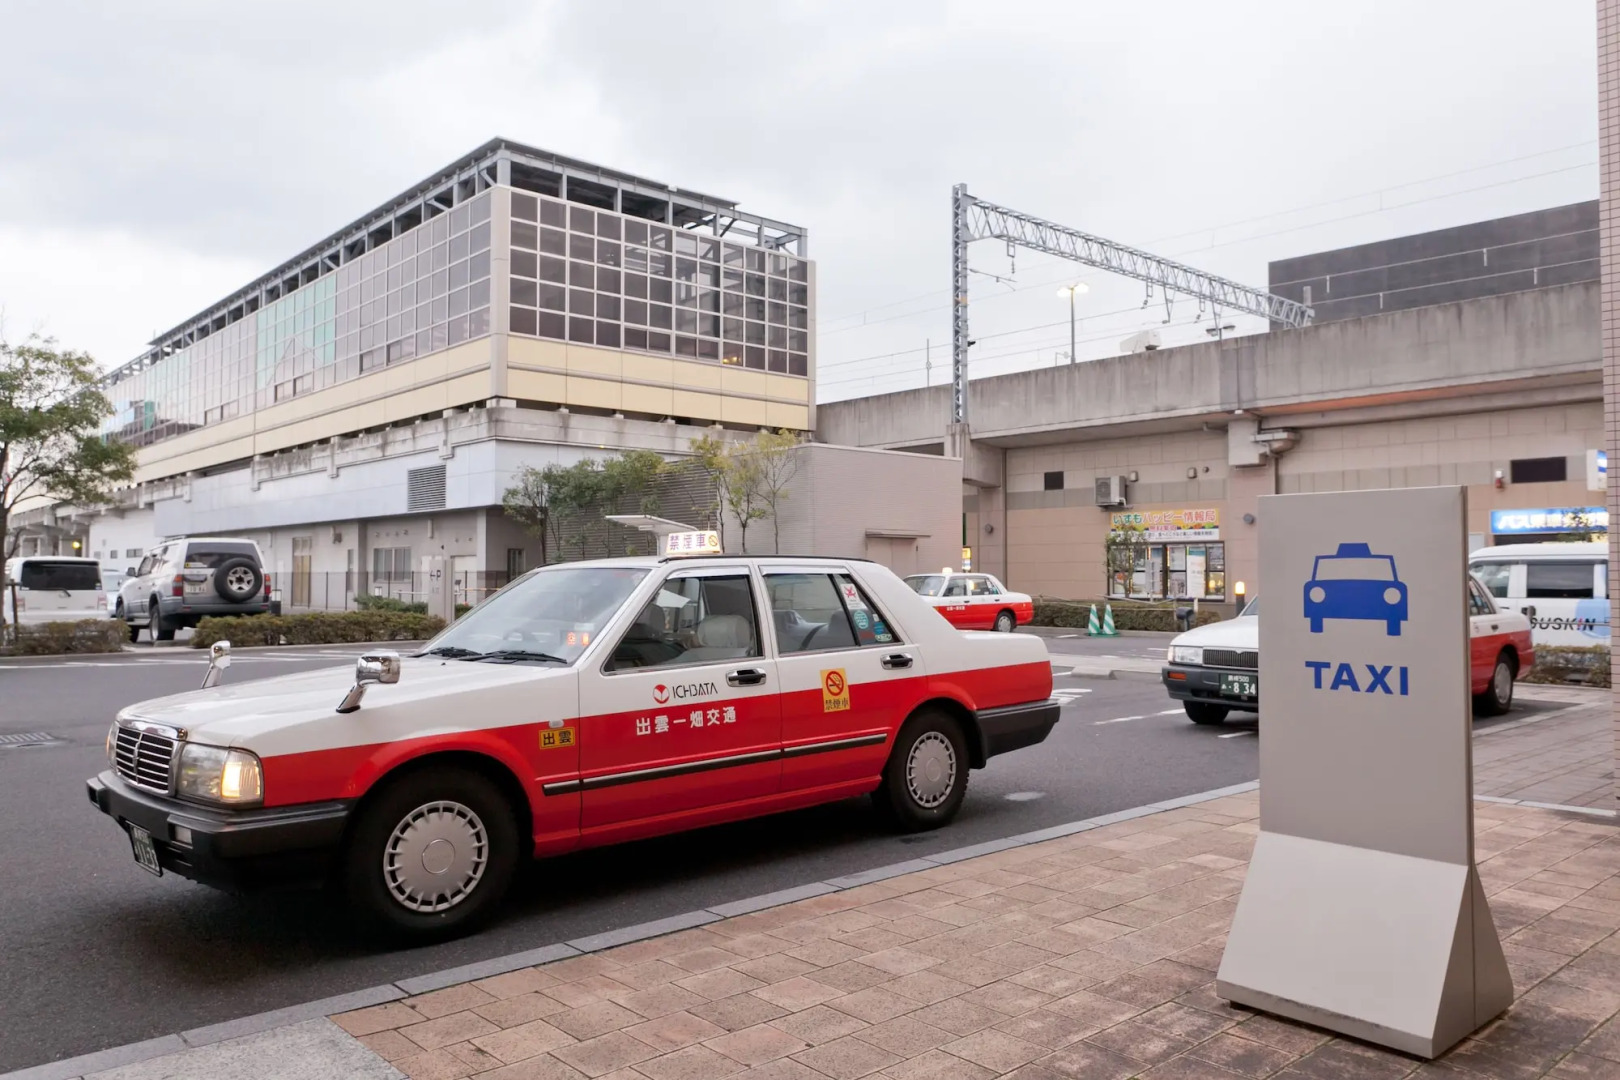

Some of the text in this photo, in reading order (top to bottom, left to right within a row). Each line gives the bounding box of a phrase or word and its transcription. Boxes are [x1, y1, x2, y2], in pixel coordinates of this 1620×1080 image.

[670, 533, 706, 550] 禁煙車
[1305, 661, 1409, 696] TAXI
[636, 706, 736, 736] 出雲一畑交通
[543, 731, 571, 746] 出雲
